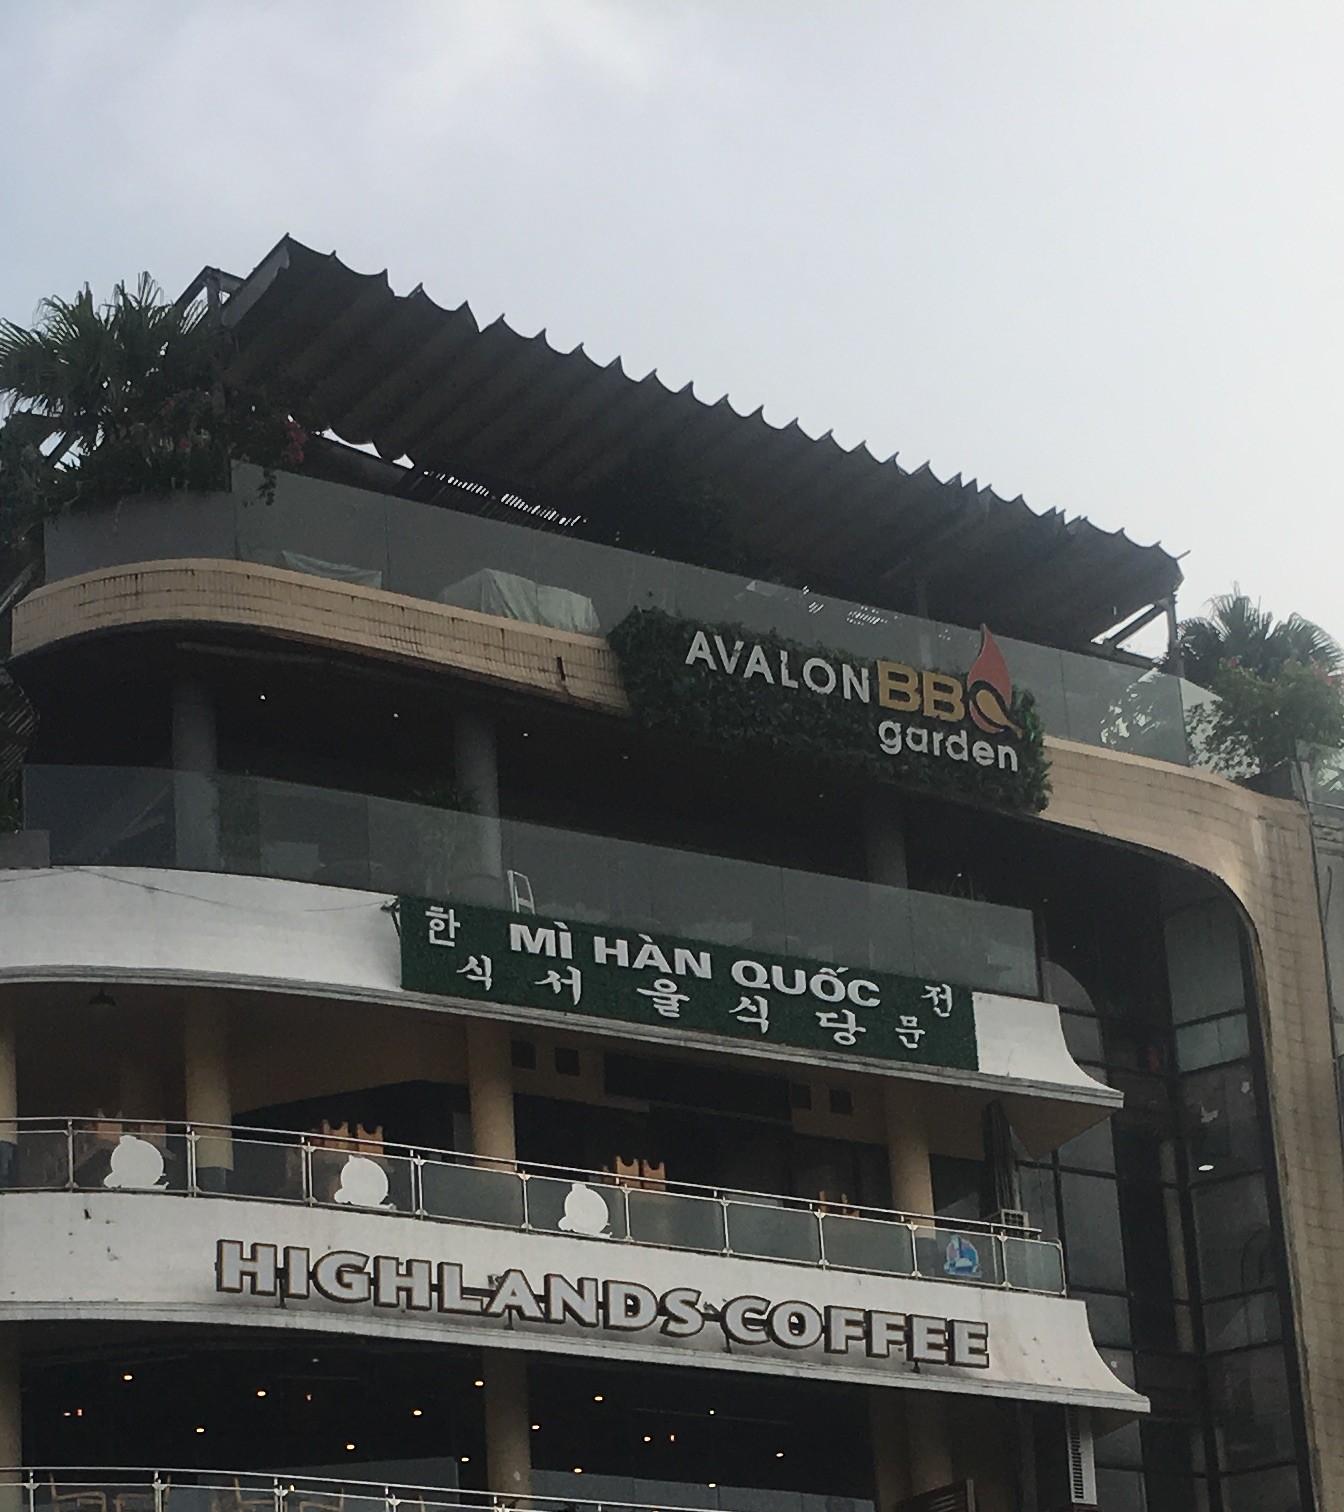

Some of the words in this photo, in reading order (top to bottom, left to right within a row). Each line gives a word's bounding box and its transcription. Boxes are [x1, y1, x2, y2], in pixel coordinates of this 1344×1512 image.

[684, 630, 871, 704] AVALON
[876, 659, 1024, 740] BBQ
[878, 720, 1019, 772] garden
[509, 920, 573, 960] MÌ
[593, 933, 712, 979] HÀN
[730, 959, 881, 1008] QUỐC
[216, 1238, 703, 1337] HIGHLANDS
[722, 1294, 990, 1369] COFFEE
